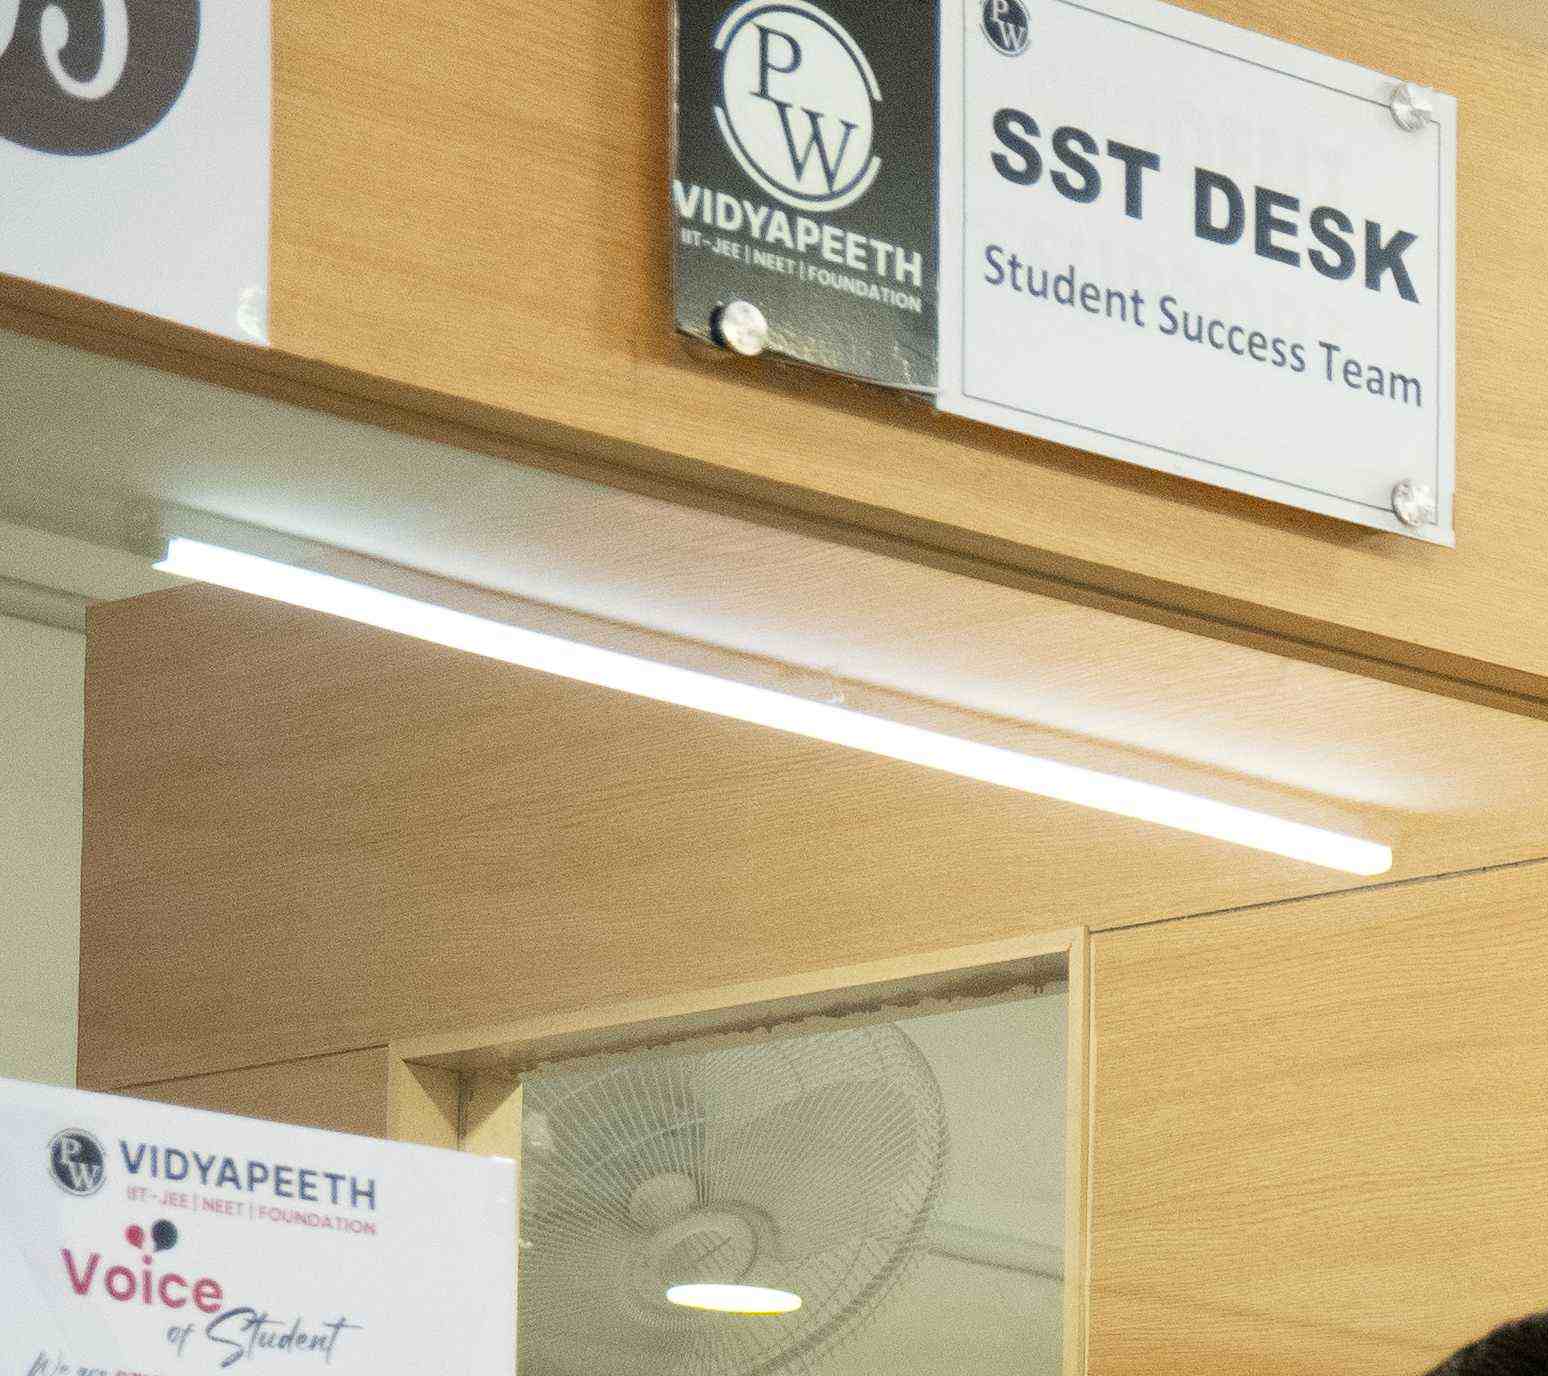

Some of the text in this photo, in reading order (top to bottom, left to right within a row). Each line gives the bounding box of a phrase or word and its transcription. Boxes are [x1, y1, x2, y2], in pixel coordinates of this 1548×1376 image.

[672, 179, 923, 286] VIDYAPEETH
[990, 107, 1420, 303] SST DESK
[750, 248, 796, 276] NEET
[806, 259, 923, 313] FOUNDATION
[984, 243, 1423, 407] Student Success Team
[119, 1140, 377, 1210] VIDYAPEETH
[202, 1197, 243, 1215] NEET
[258, 1206, 378, 1236] FOUNDATION
[60, 1248, 224, 1313] Voice
[166, 1305, 363, 1368] of Student
